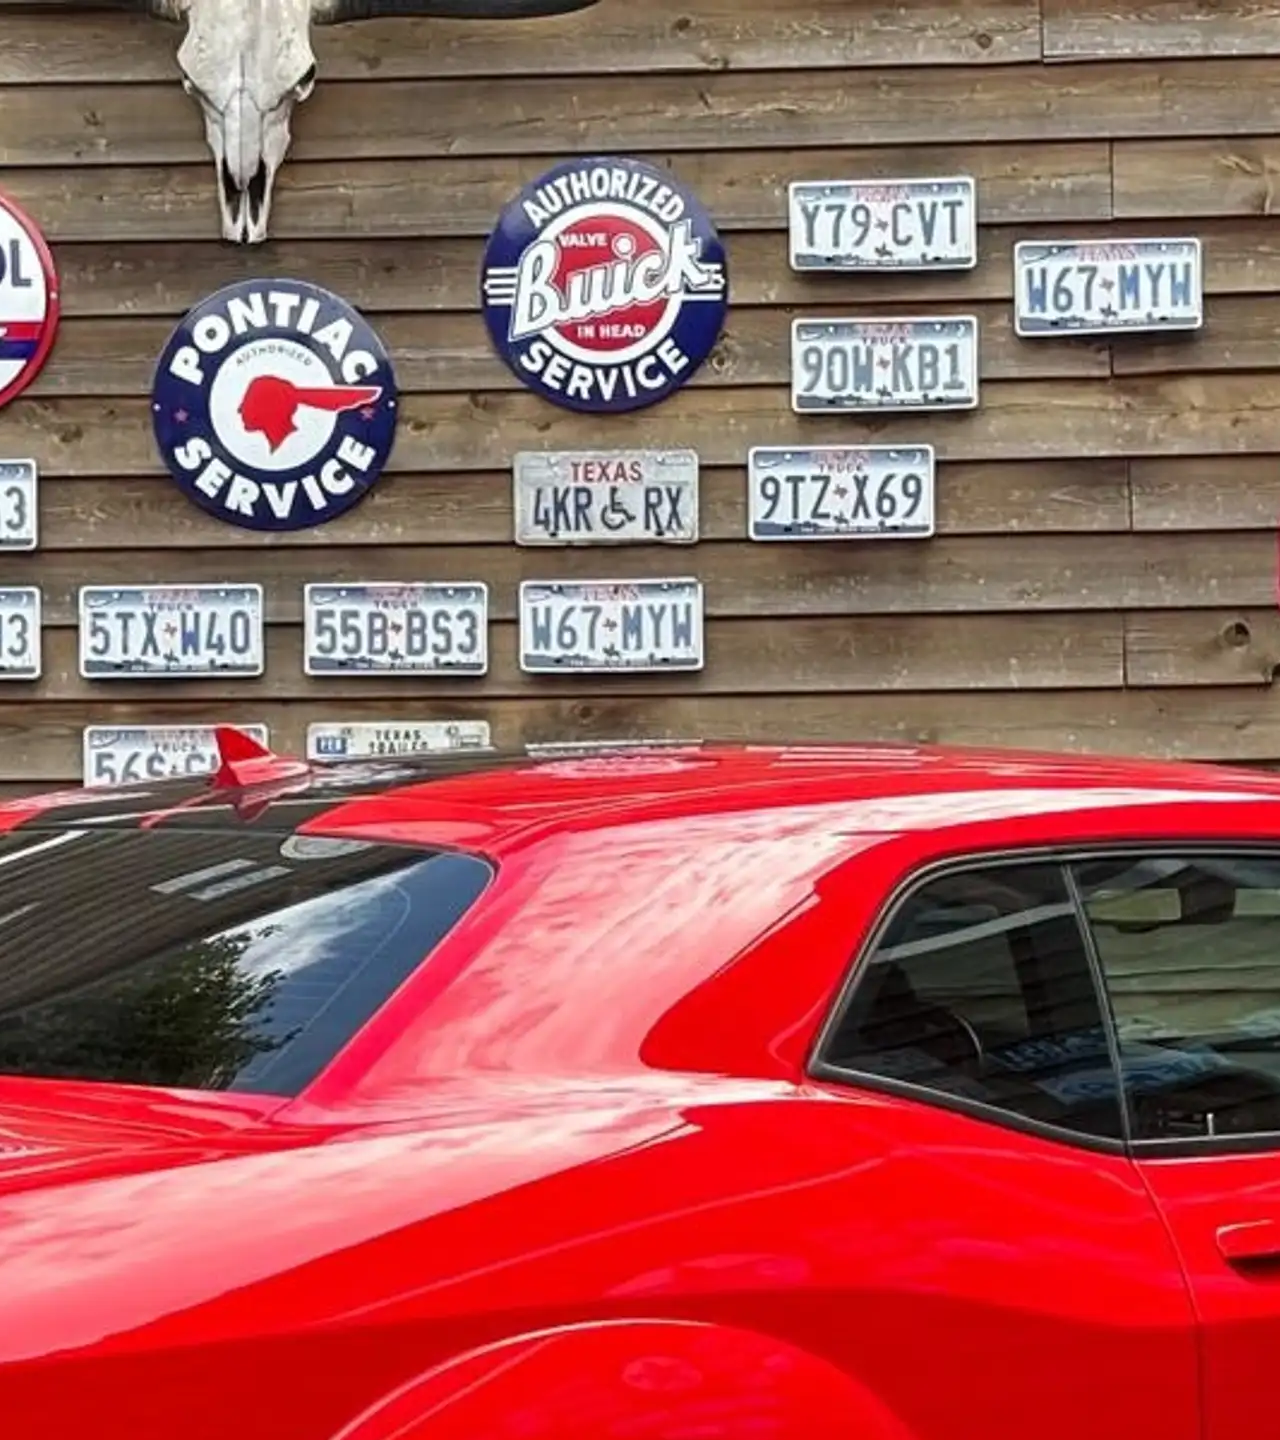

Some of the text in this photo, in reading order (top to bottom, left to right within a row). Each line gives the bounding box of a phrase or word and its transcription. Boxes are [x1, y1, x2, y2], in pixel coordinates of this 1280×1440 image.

[522, 167, 684, 228] AUTHORIZED
[558, 233, 608, 247] VALVE
[800, 200, 964, 248] Y79 CVT
[508, 219, 710, 342] Buick
[1025, 262, 1192, 313] W67 MYW
[169, 291, 378, 386] PONTIAC
[577, 323, 646, 339] IN HEAD
[520, 339, 689, 402] SERVICE
[174, 435, 376, 519] SERVICE
[571, 460, 643, 482] TEXAS
[533, 486, 684, 534] 4KR RX
[759, 473, 922, 520] 9TZ X69
[314, 608, 479, 656] 55B BS3
[530, 602, 693, 651] W67 MYW
